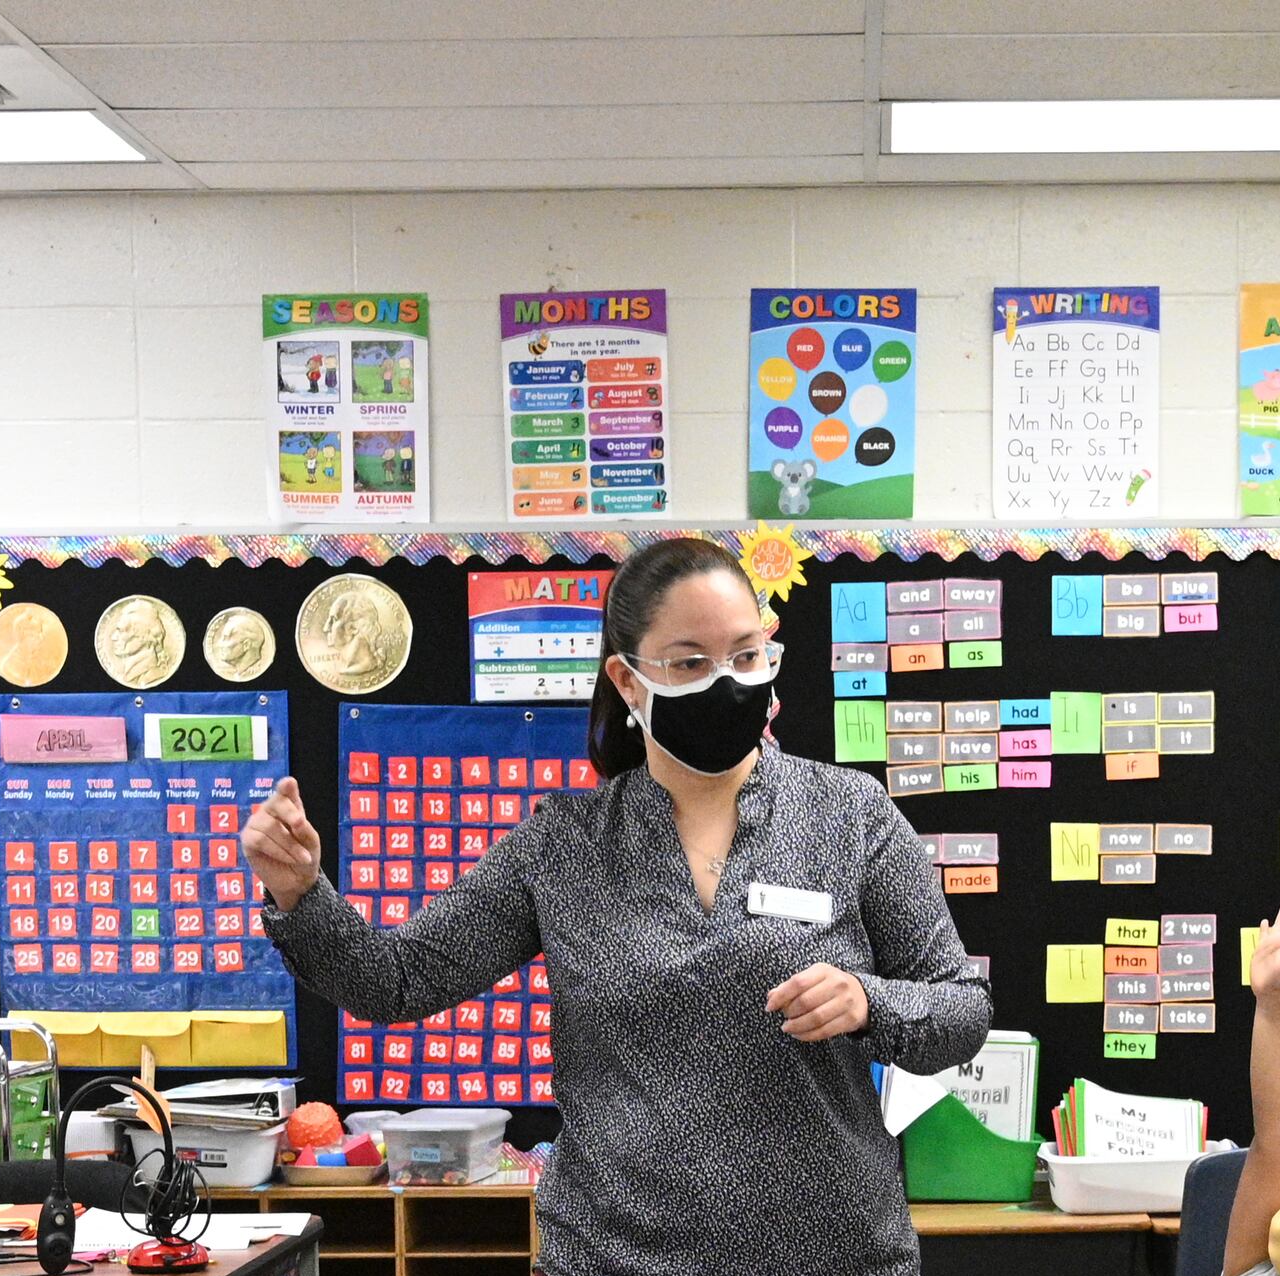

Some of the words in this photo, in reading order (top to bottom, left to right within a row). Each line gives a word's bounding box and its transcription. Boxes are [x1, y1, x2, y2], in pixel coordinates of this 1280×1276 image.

[514, 297, 652, 324] MONTHS
[770, 295, 902, 319] COLORS
[1030, 293, 1150, 315] WRITING
[273, 300, 419, 325] SEASONS
[526, 366, 565, 375] January
[614, 363, 634, 372] July
[525, 392, 568, 401] February
[608, 390, 642, 399] August
[285, 406, 335, 414] WINTER
[360, 405, 406, 414] SPRING
[532, 418, 563, 426] March
[600, 415, 651, 424] September
[768, 425, 799, 433] PURPLE
[537, 444, 560, 454] April
[607, 442, 647, 450] October
[863, 442, 889, 450] BLACK
[603, 468, 652, 476] November
[283, 495, 339, 504] SUMMER
[358, 495, 412, 504] AUTUMN
[604, 494, 653, 502] December
[504, 577, 599, 601] MATH
[1172, 581, 1208, 594] blue
[900, 588, 930, 603] and
[950, 588, 996, 603] away
[963, 617, 983, 630] all
[1178, 612, 1202, 625] but
[478, 623, 520, 632] Addition
[847, 651, 875, 664] are
[479, 664, 537, 673] Subtraction
[894, 710, 932, 723] here
[955, 709, 990, 724] help
[1012, 706, 1039, 718] had
[36, 728, 92, 751] APRIL
[171, 723, 240, 754] 2021
[1012, 738, 1037, 750] has
[950, 742, 991, 755] have
[899, 773, 932, 786] how
[4, 790, 33, 800] Sunday
[45, 790, 74, 800] Monday
[85, 790, 117, 800] Tuesday
[122, 790, 160, 800] Wednesday
[166, 789, 200, 800] Thursday
[212, 789, 236, 800] Friday
[1109, 833, 1142, 845] now
[958, 844, 982, 856] my
[950, 874, 991, 886] made
[54, 882, 75, 898] 12
[136, 915, 157, 930] 21
[1118, 926, 1147, 939] that
[218, 950, 239, 966] 30
[1115, 955, 1147, 967] than
[1118, 981, 1146, 994] this
[1173, 981, 1210, 992] three
[1170, 1011, 1206, 1024] take
[1114, 1040, 1146, 1054] they
[957, 1062, 984, 1080] My
[499, 1080, 516, 1096] 95
[1121, 1106, 1147, 1122] My
